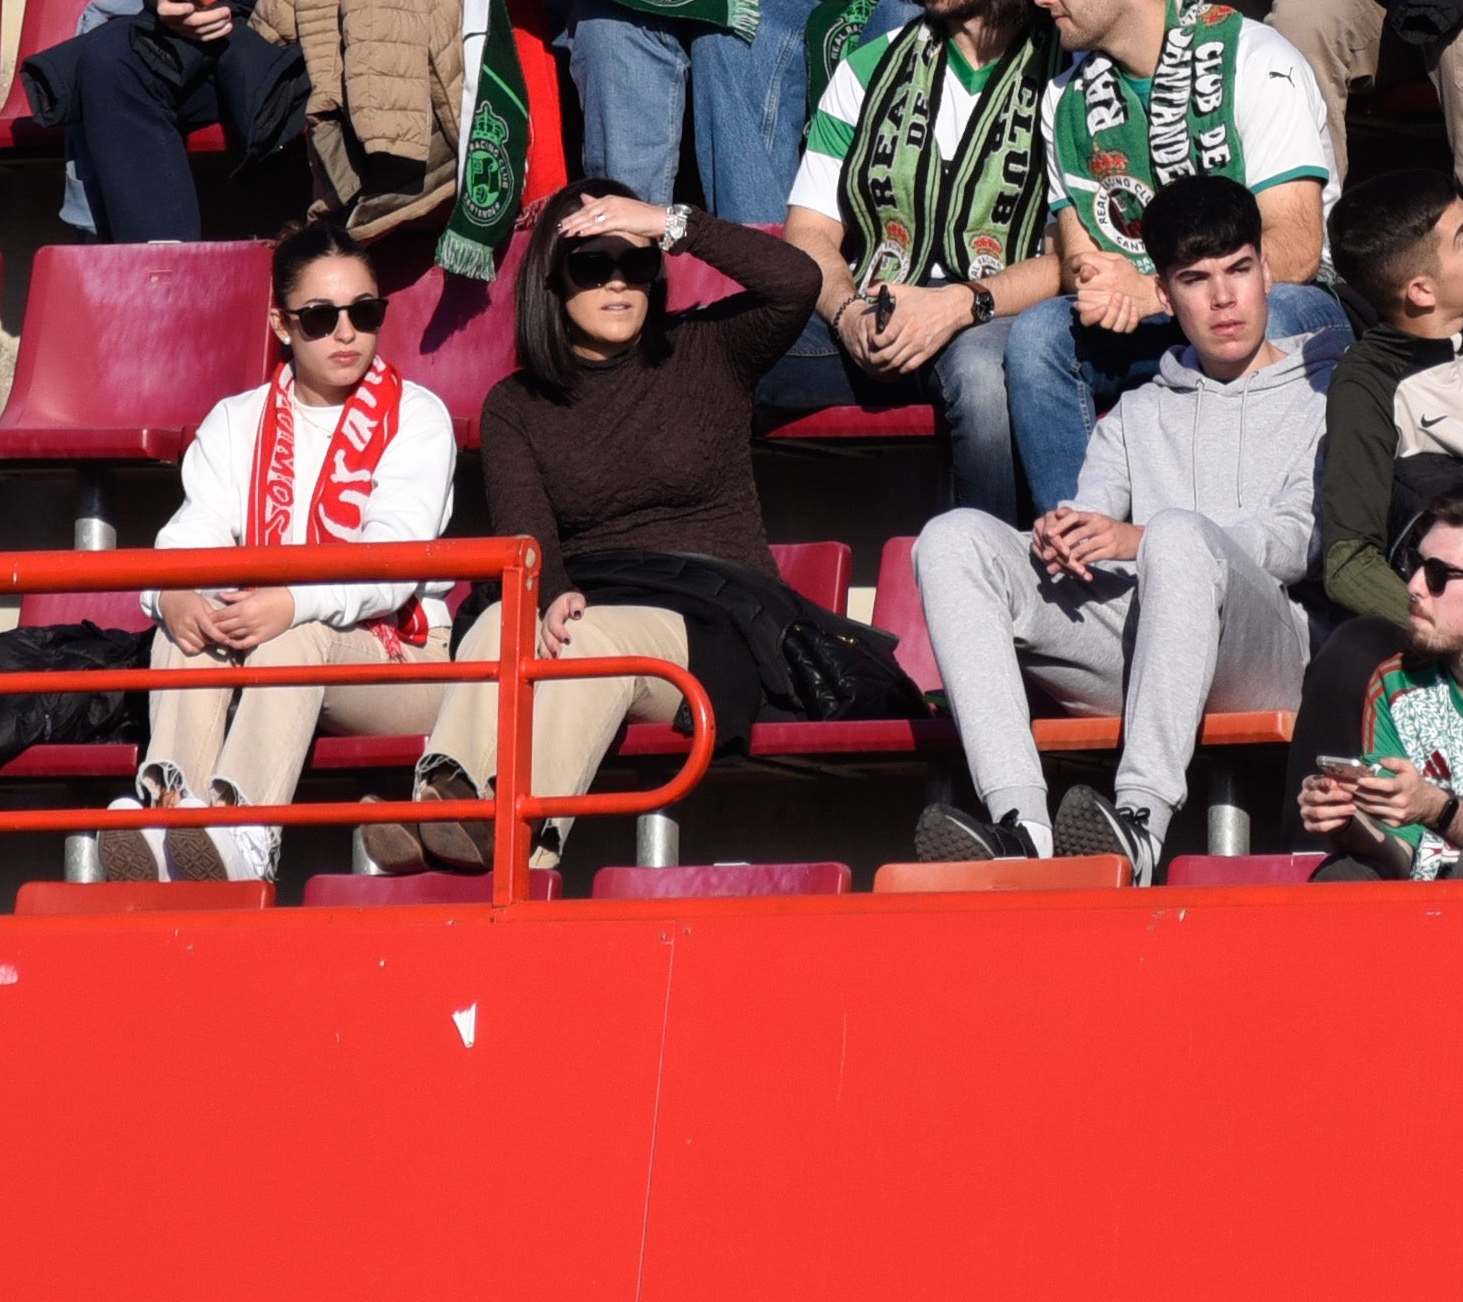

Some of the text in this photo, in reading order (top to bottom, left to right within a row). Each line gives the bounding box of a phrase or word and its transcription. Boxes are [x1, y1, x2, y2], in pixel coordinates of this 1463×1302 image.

[1149, 27, 1198, 188] SANTANDE
[1193, 40, 1227, 115] CLUB
[988, 76, 1040, 229] CLUB
[1198, 124, 1233, 170] DE
[1098, 194, 1111, 225] REAL
